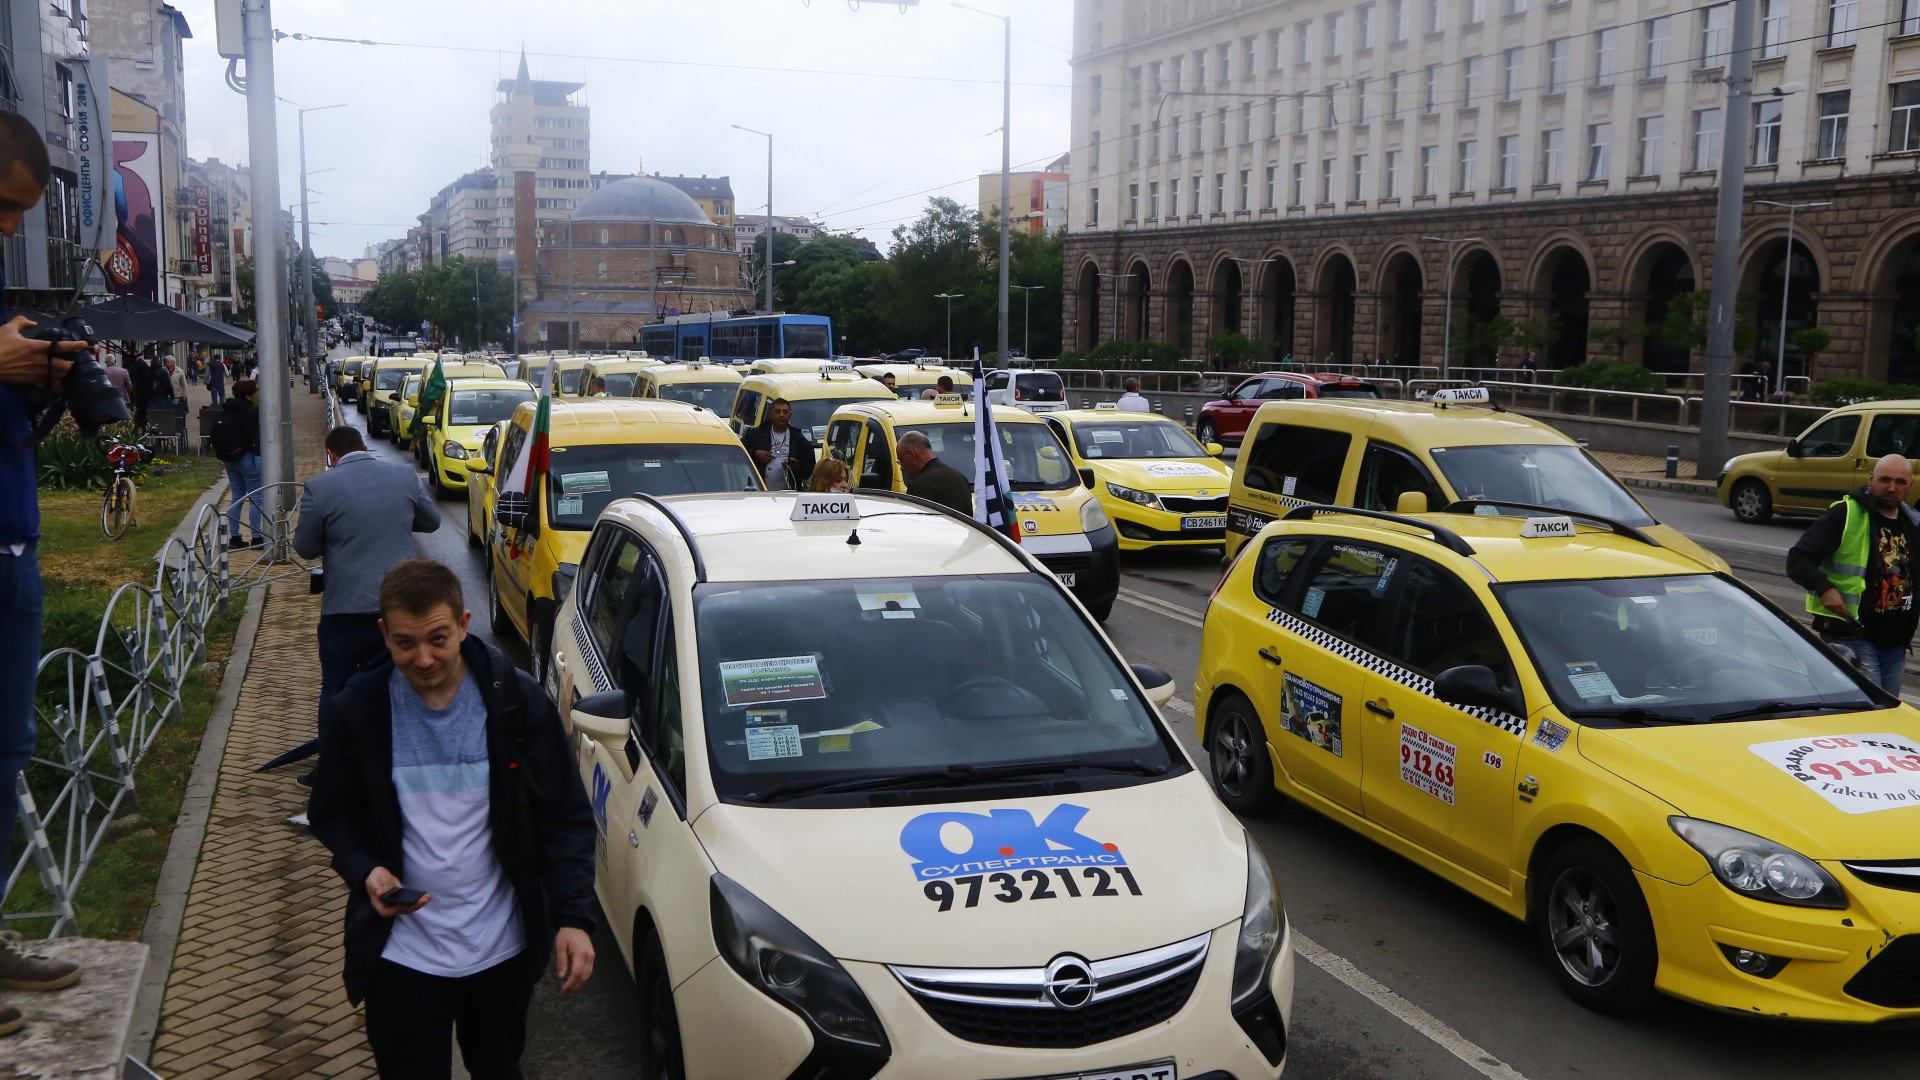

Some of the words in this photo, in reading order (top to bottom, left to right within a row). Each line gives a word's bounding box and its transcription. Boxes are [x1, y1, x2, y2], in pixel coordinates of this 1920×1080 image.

[78, 111, 90, 151] СОФИЯ
[80, 155, 93, 227] ОФИСЦЕНТЪР
[1453, 389, 1483, 400] ТАКСИ
[802, 502, 850, 515] ТАКСИ
[1198, 517, 1217, 527] 2461
[1534, 522, 1569, 533] ТАКСИ
[1483, 752, 1502, 769] 198
[1821, 781, 1880, 800] Такси
[920, 853, 1119, 878] СУПЕРТРАНС
[923, 865, 1143, 913] 9732121
